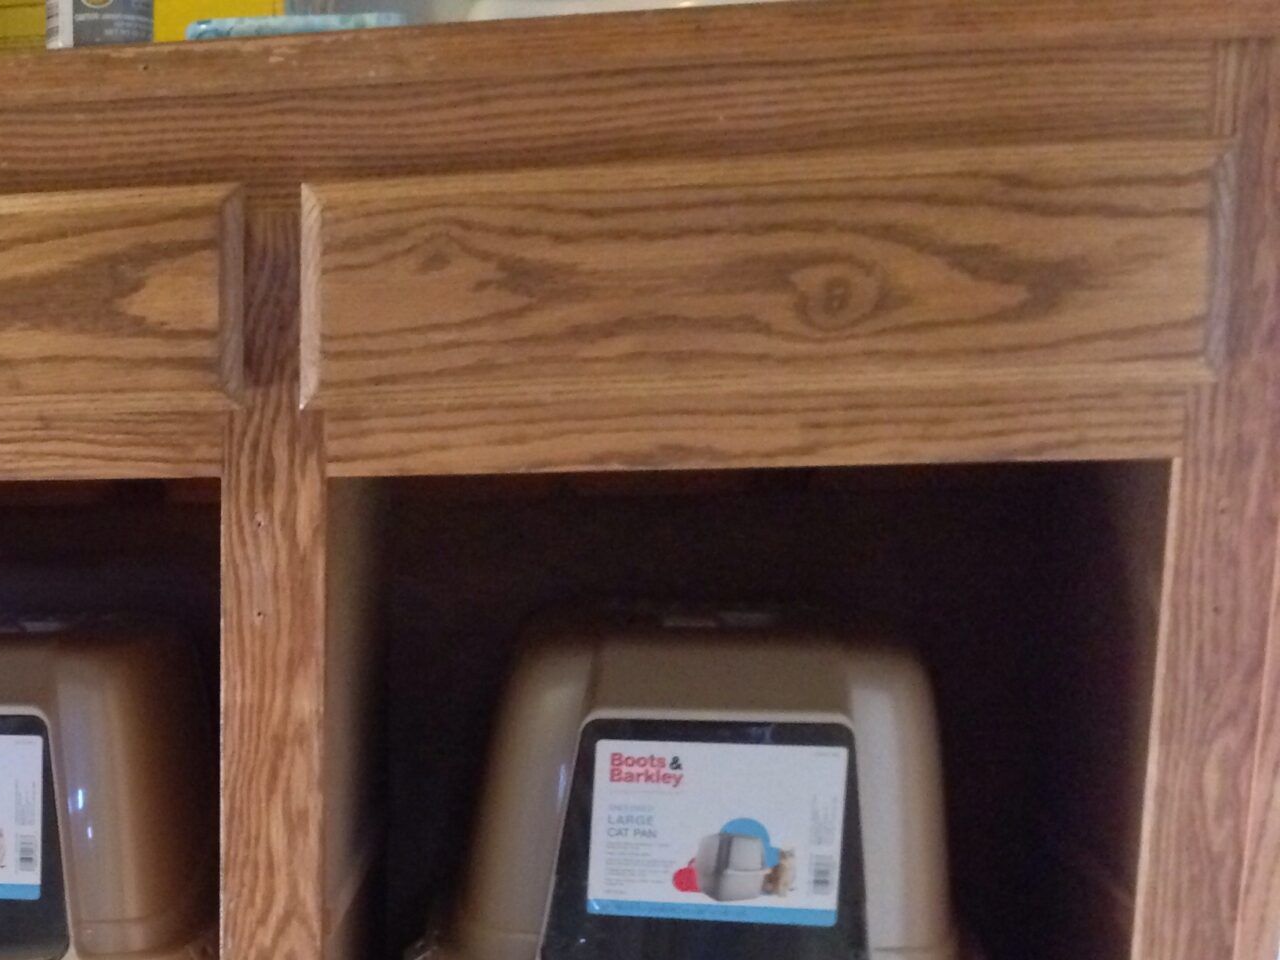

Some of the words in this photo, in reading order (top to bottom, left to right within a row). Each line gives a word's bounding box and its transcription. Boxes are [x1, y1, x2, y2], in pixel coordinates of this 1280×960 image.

[609, 752, 666, 768] Boots
[670, 756, 683, 770] &
[609, 767, 684, 788] Barkley
[607, 815, 654, 826] LARGE
[606, 827, 630, 838] CAT
[633, 827, 658, 839] PAN
